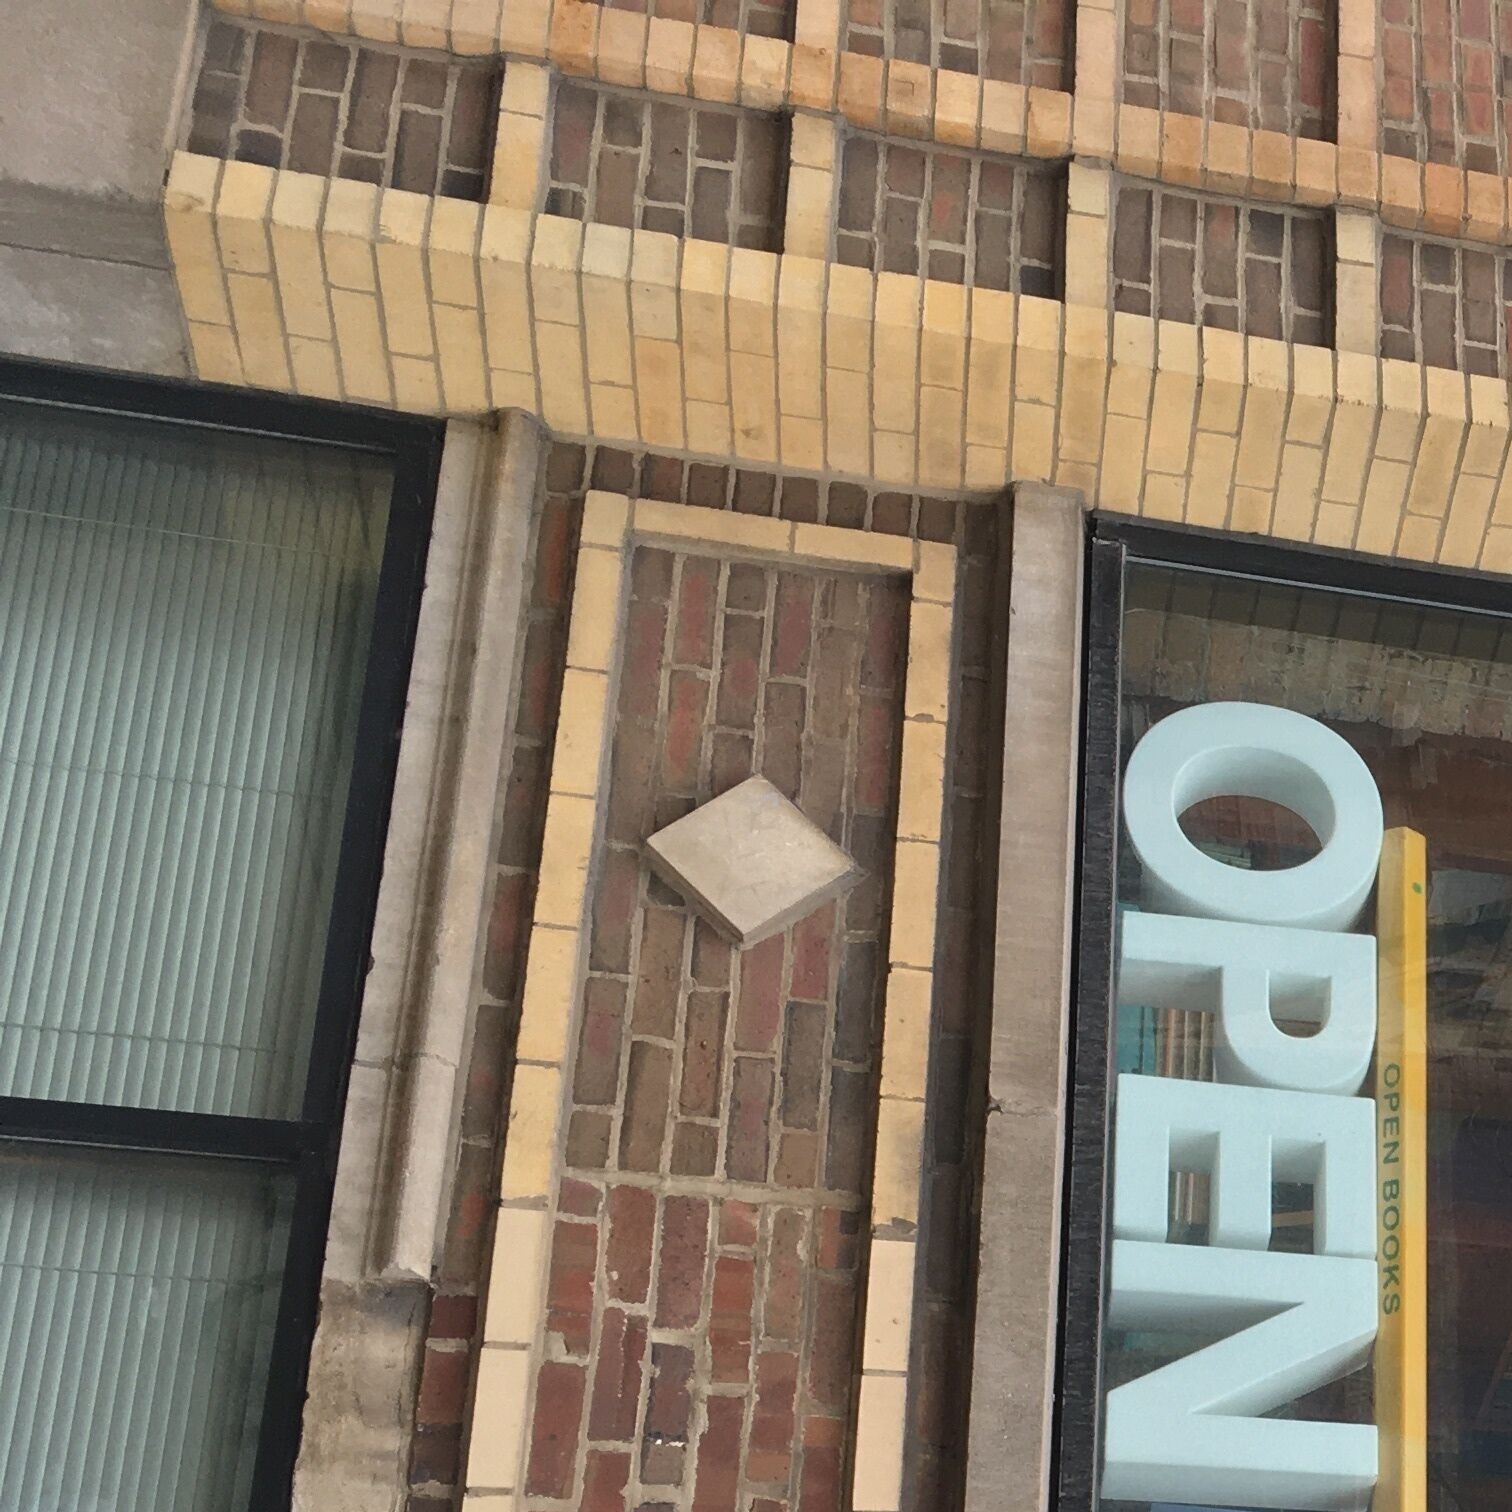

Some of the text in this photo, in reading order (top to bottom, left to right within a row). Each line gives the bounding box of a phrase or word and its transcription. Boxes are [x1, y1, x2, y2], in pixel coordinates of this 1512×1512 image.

[1103, 701, 1384, 1511] OPEN
[1382, 1063, 1401, 1316] OPEN BOOKS
